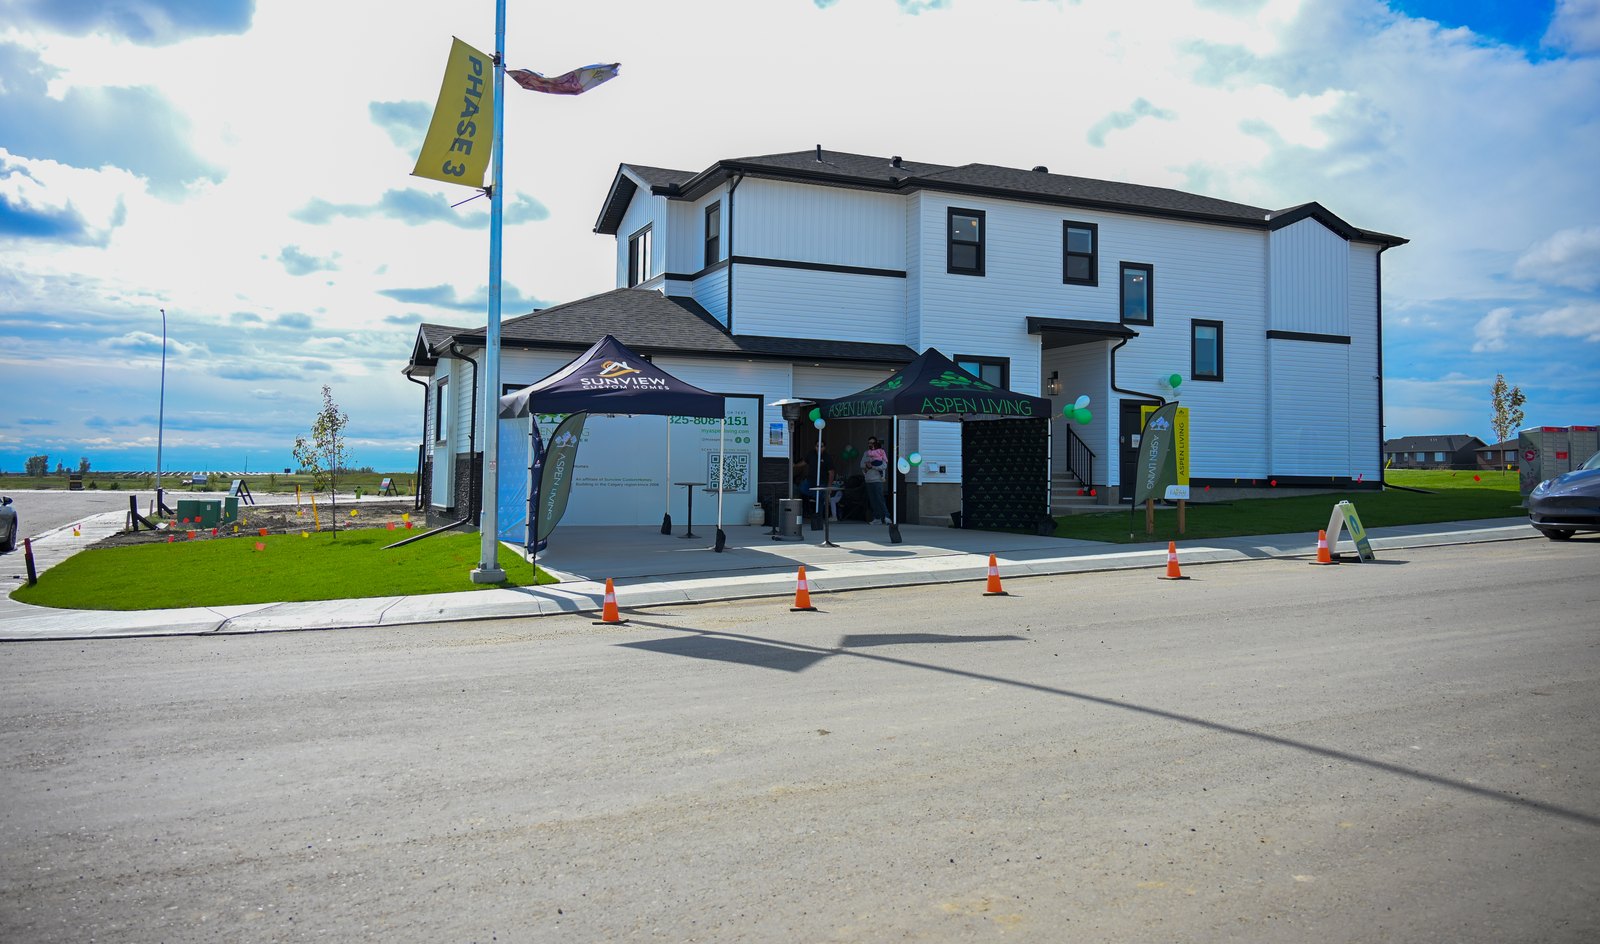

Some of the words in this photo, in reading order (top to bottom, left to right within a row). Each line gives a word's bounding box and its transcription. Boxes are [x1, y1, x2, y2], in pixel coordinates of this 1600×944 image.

[450, 55, 483, 156] PHASE
[442, 160, 466, 177] 3
[580, 377, 665, 386] SUNVIEW
[828, 401, 856, 417] ASPEN
[856, 399, 884, 415] LIVING
[921, 397, 977, 414] ASPEN
[980, 399, 1032, 416] LIVING
[1149, 434, 1160, 461] ASPEN
[554, 452, 566, 486] ASPEN
[1146, 463, 1157, 490] LIVING
[546, 488, 557, 520] LIVING
